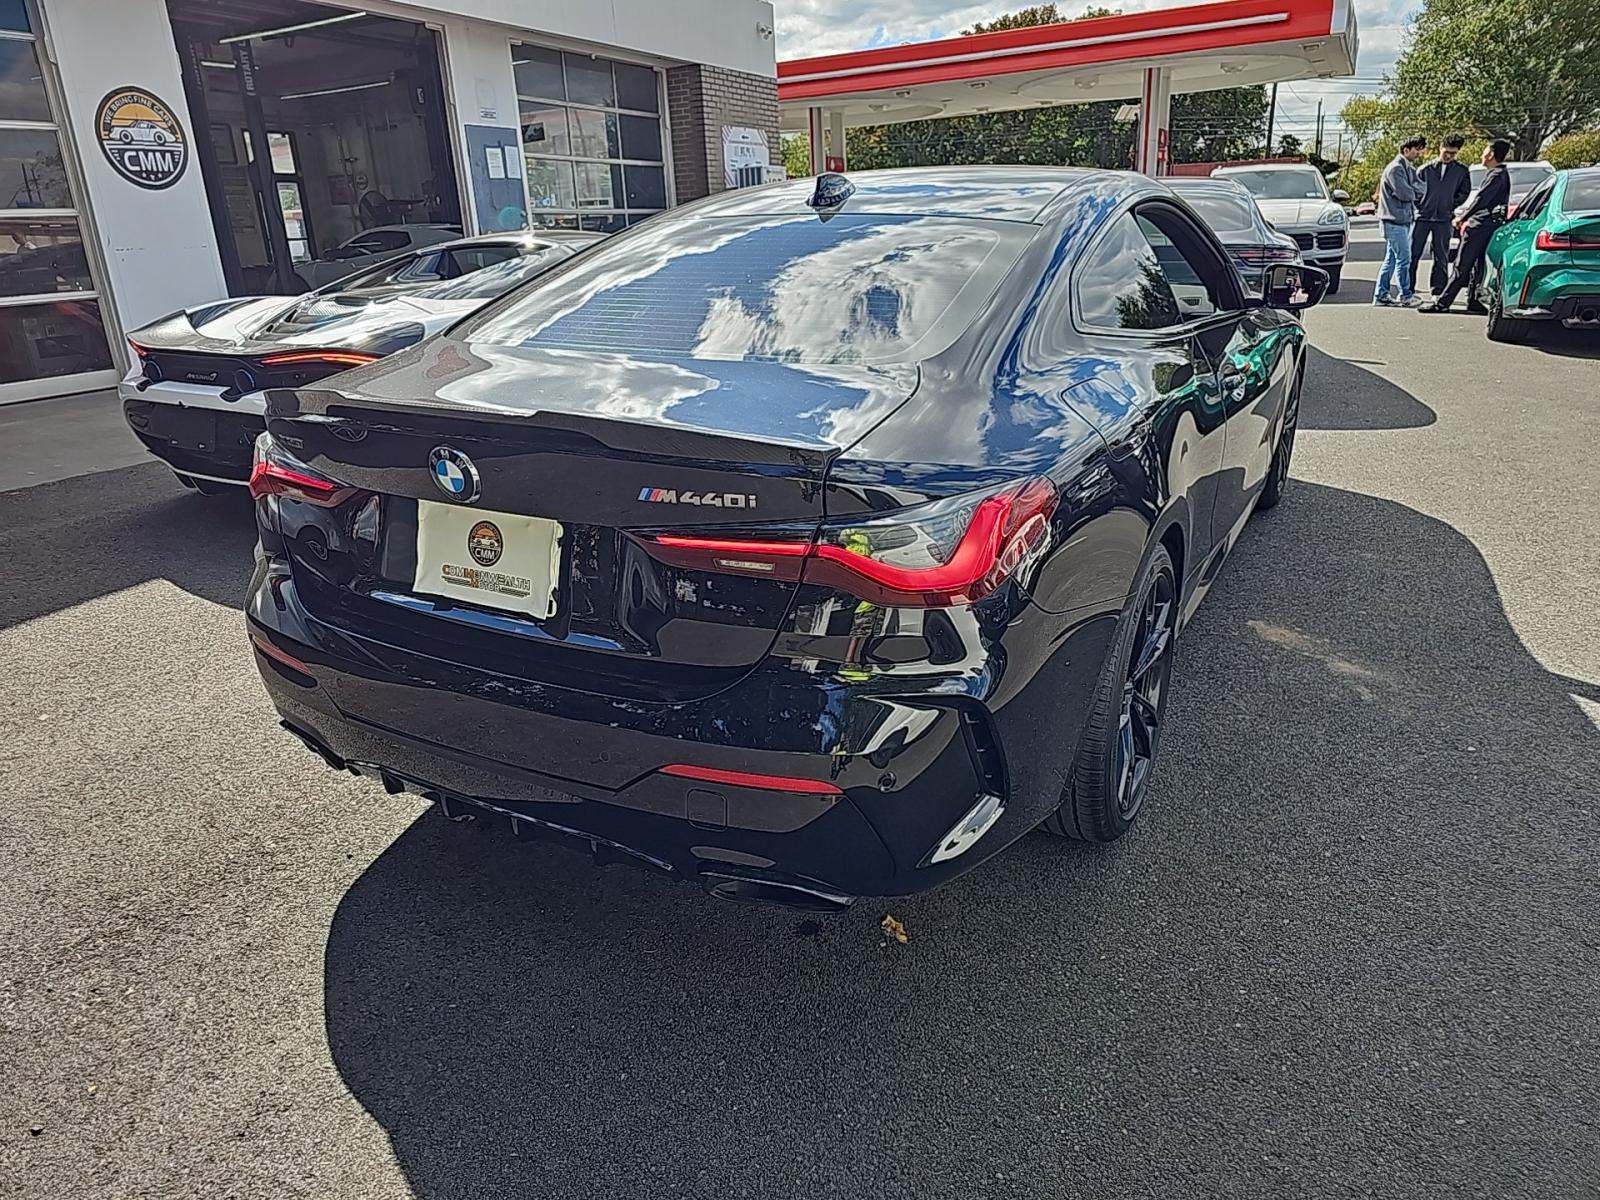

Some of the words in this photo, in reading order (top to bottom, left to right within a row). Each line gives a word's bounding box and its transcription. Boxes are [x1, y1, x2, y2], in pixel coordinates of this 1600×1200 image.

[104, 110, 114, 124] WE
[111, 96, 134, 111] BRING
[133, 95, 153, 108] FINE
[123, 151, 175, 172] CMM
[431, 449, 467, 470] BMW
[655, 487, 757, 509] M440i
[474, 548, 496, 560] CMM
[441, 564, 531, 592] COMMONWEALTH
